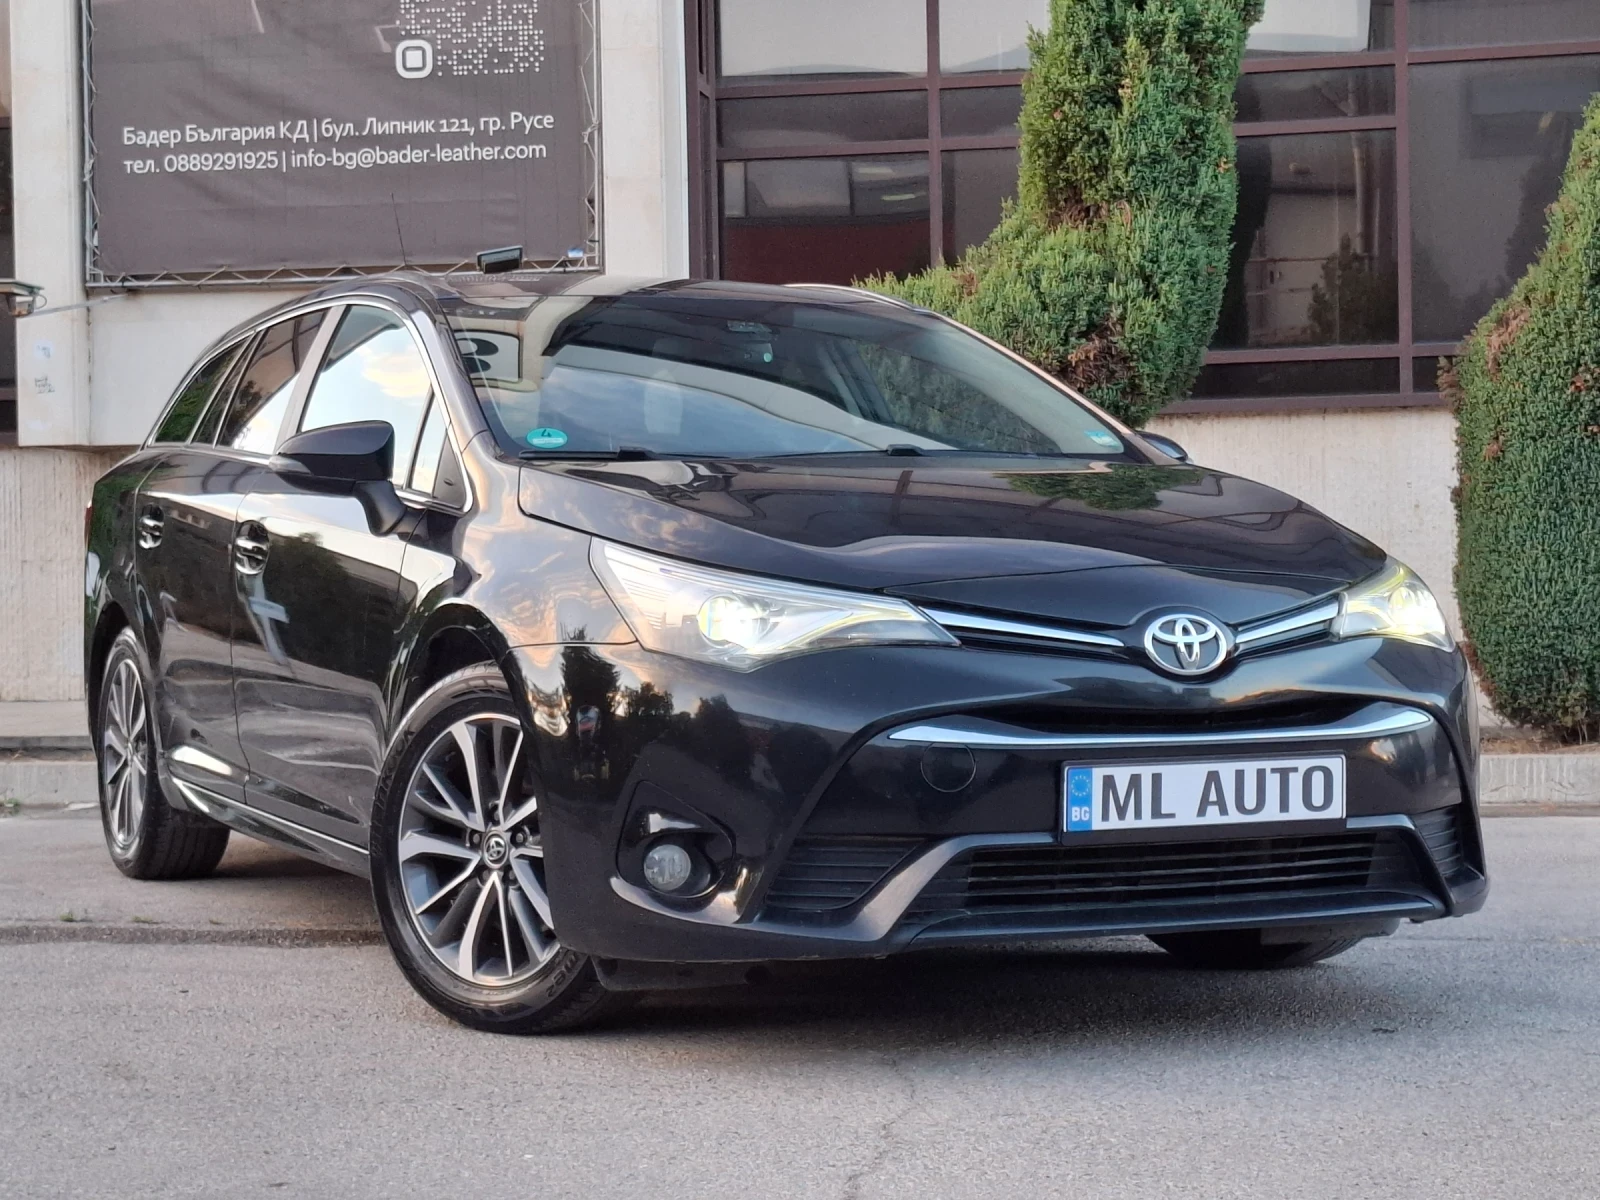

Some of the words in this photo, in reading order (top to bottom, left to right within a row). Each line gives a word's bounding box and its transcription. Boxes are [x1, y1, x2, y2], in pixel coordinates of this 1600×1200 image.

[123, 126, 181, 148] Бадер
[185, 124, 275, 146] България
[279, 119, 310, 143] КД
[321, 118, 359, 142] бул.
[362, 117, 435, 137] Липник
[439, 118, 475, 137] 121,
[480, 115, 506, 136] гр.
[510, 111, 555, 135] Русе
[123, 159, 160, 173] тел.
[164, 150, 278, 173] 0889291925
[291, 142, 547, 170] info-bg@bader-leather.com
[1101, 772, 1177, 823] ML
[1196, 765, 1334, 819] AUTO
[1071, 806, 1090, 823] BG
